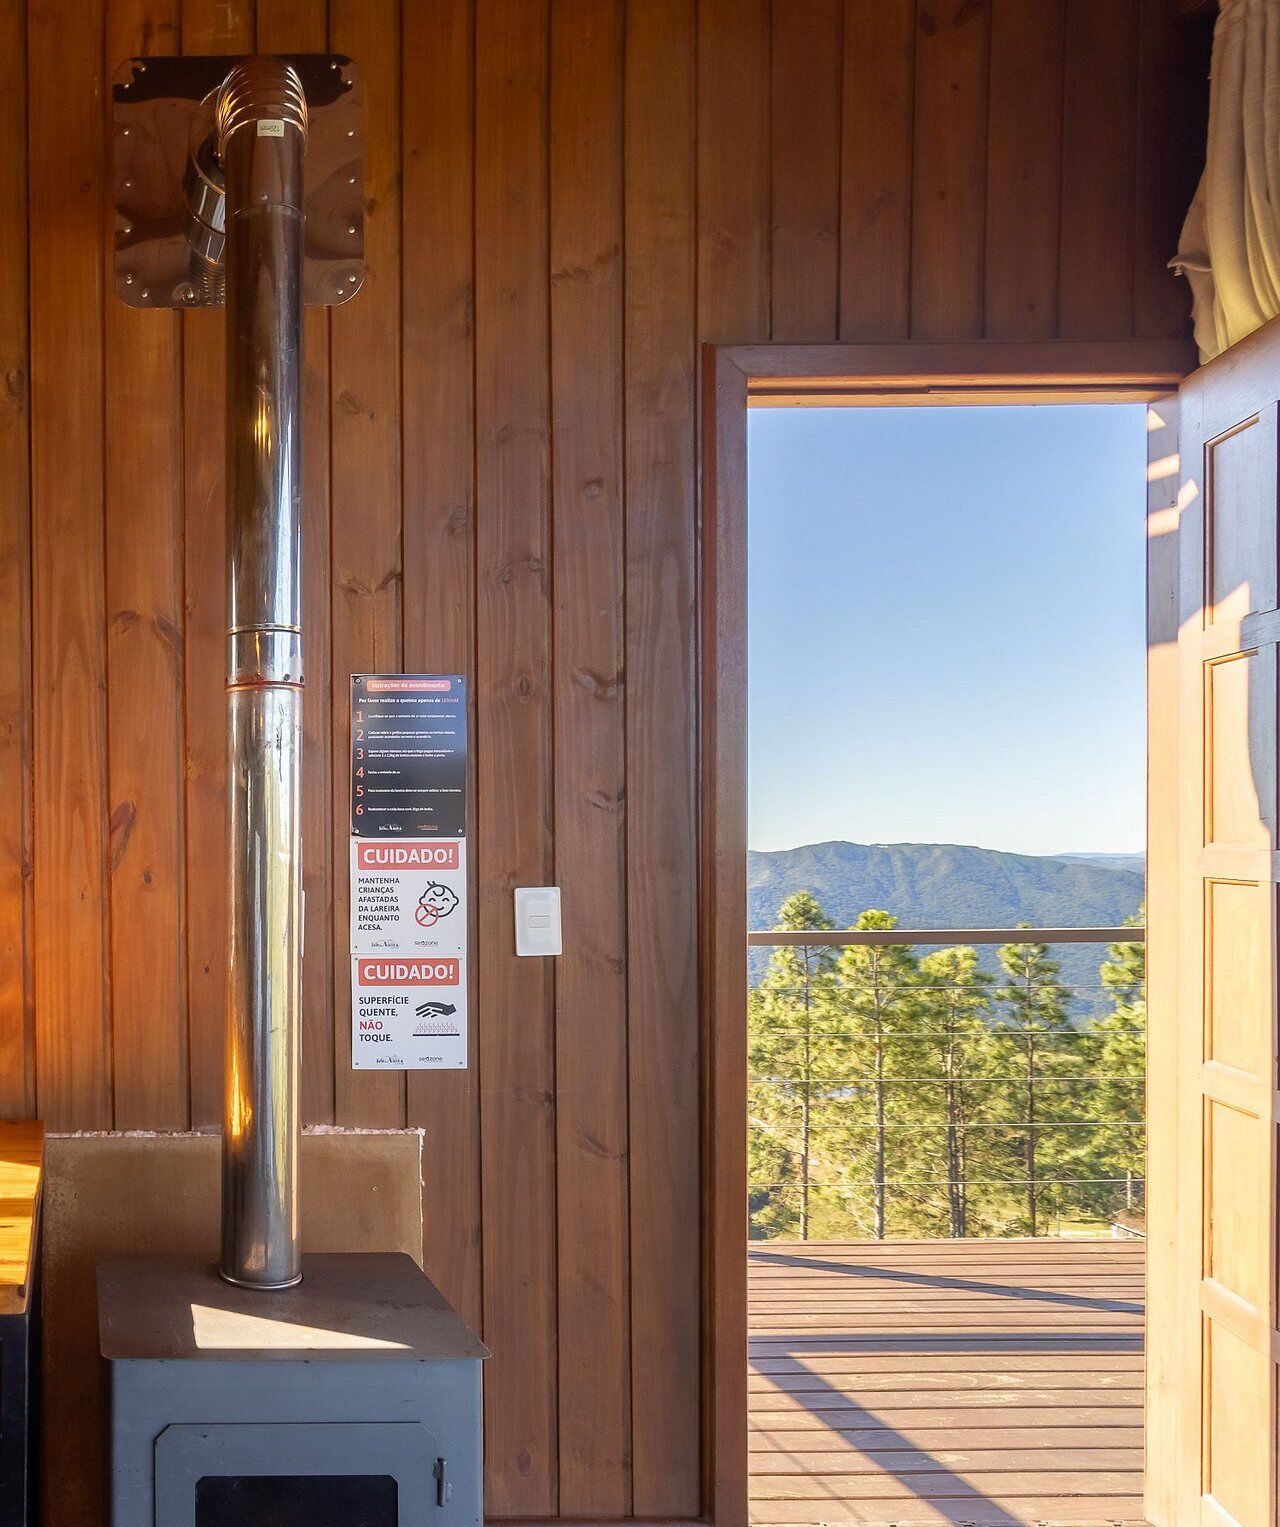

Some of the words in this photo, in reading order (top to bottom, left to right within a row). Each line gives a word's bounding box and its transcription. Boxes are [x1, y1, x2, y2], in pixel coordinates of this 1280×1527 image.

[355, 711, 364, 722] 1
[356, 730, 364, 741] 2
[356, 748, 364, 759] 3
[356, 767, 364, 778] 4
[356, 785, 364, 797] 5
[356, 804, 364, 815] 6
[363, 848, 454, 864] CUIDADO!
[363, 964, 454, 980] CUIDADO!
[358, 995, 409, 1005] SUPERFÍCIE
[359, 1008, 399, 1017] QUENTE,
[359, 1019, 383, 1030] NÃO
[359, 1033, 393, 1043] TOQUE.
